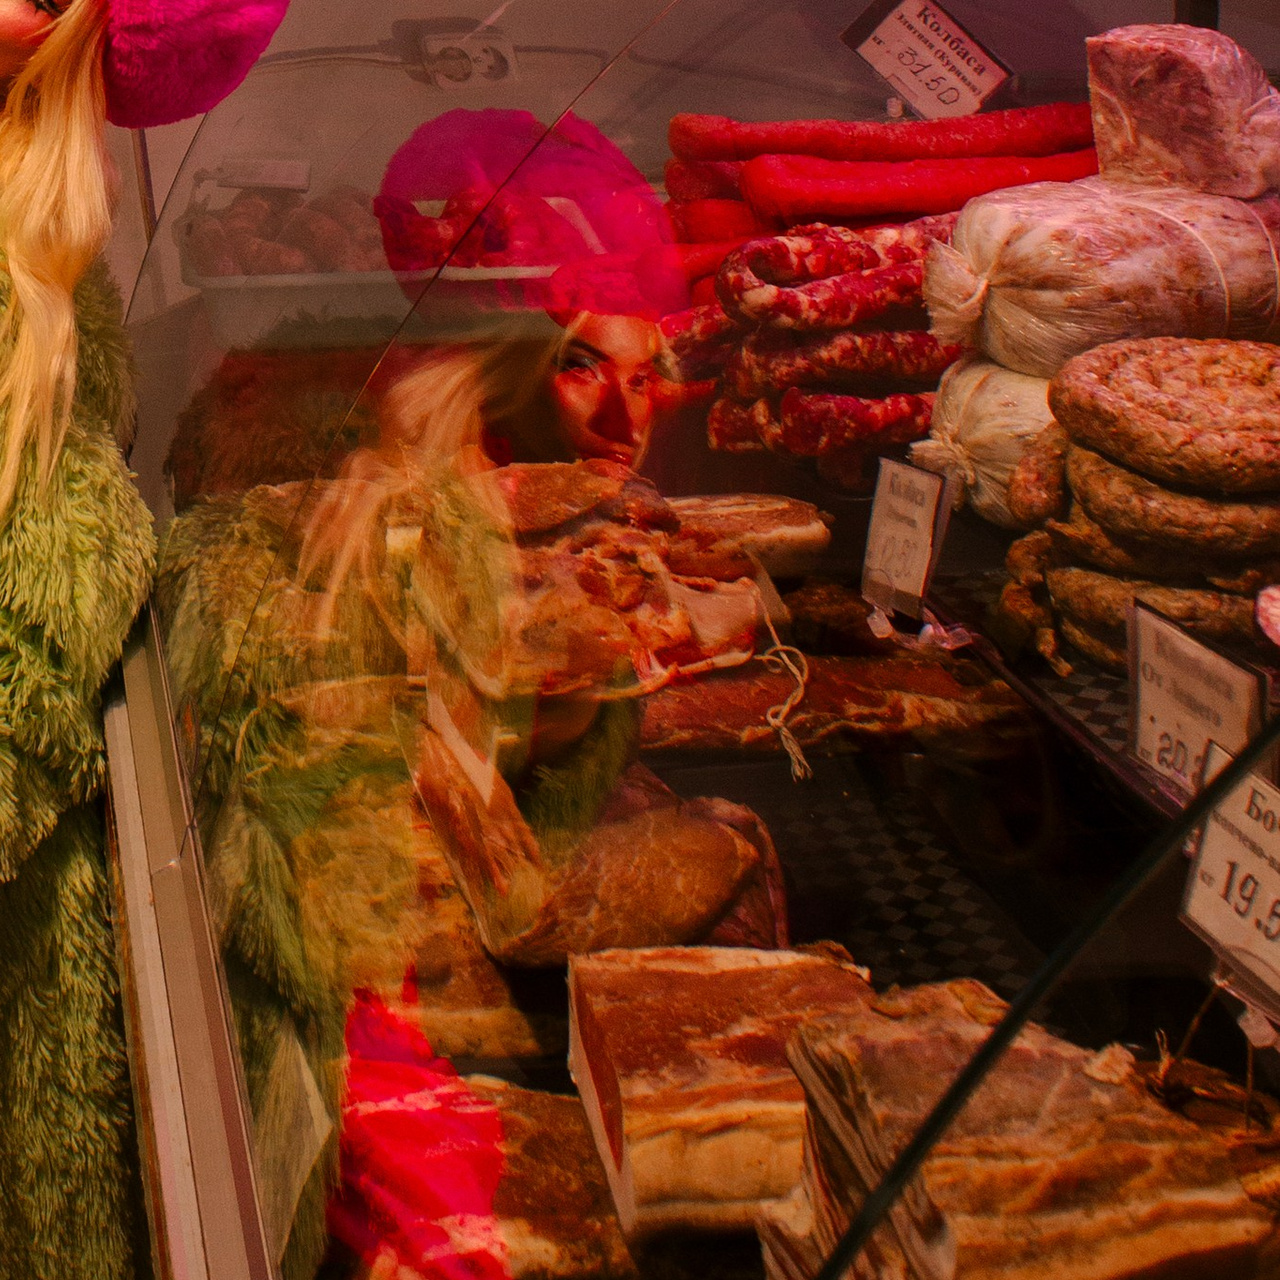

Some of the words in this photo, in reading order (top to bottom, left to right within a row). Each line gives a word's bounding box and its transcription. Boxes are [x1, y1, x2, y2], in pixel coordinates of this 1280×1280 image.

[917, 6, 986, 76] Колбаса
[898, 46, 960, 105] 31.50
[1245, 787, 1280, 832] Бо
